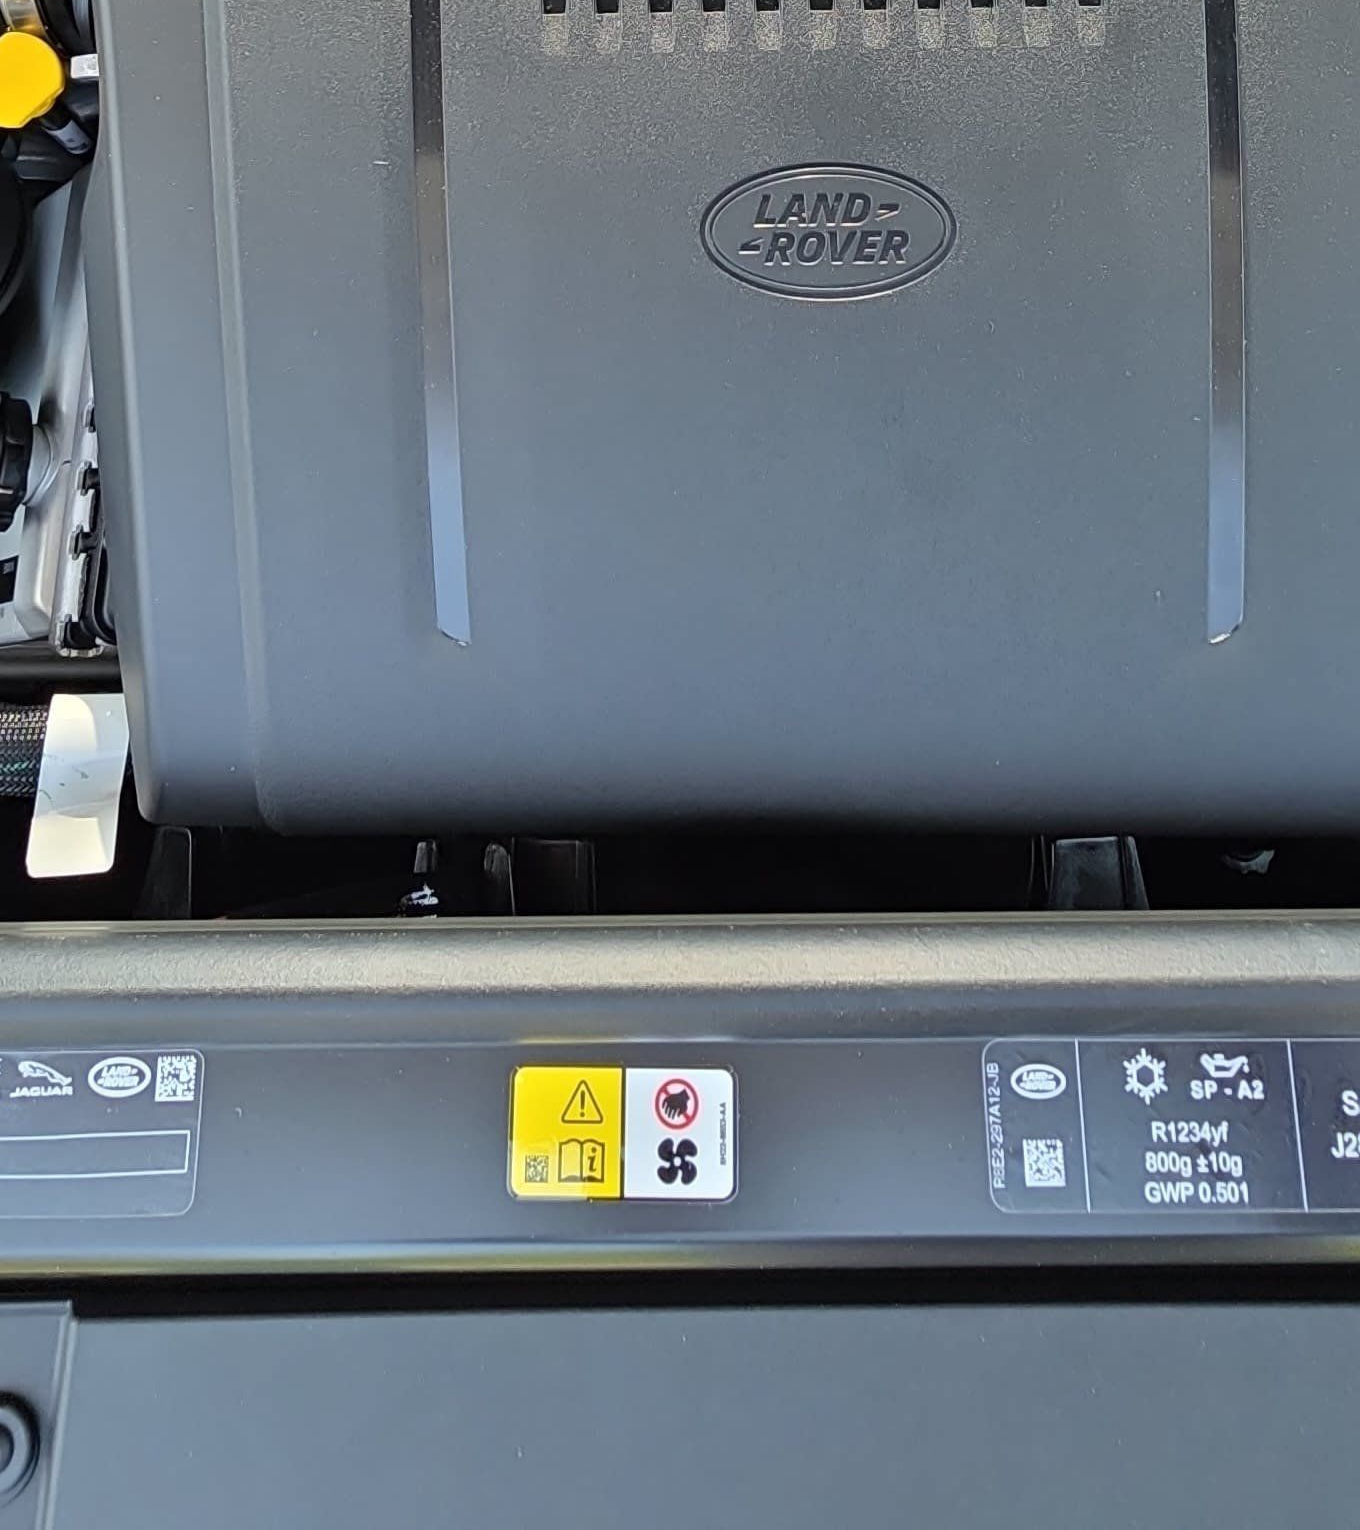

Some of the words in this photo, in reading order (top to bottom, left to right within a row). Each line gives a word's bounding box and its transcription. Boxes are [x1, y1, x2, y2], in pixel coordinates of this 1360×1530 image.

[9, 1086, 73, 1098] JAGUAR
[1190, 1080, 1218, 1100] SP
[1237, 1080, 1265, 1100] A2
[1151, 1121, 1228, 1147] R1234yf
[1145, 1151, 1192, 1177] 800g
[1197, 1151, 1242, 1176] ±10g
[1144, 1182, 1192, 1203] GWP
[1198, 1181, 1249, 1204] 0.501
